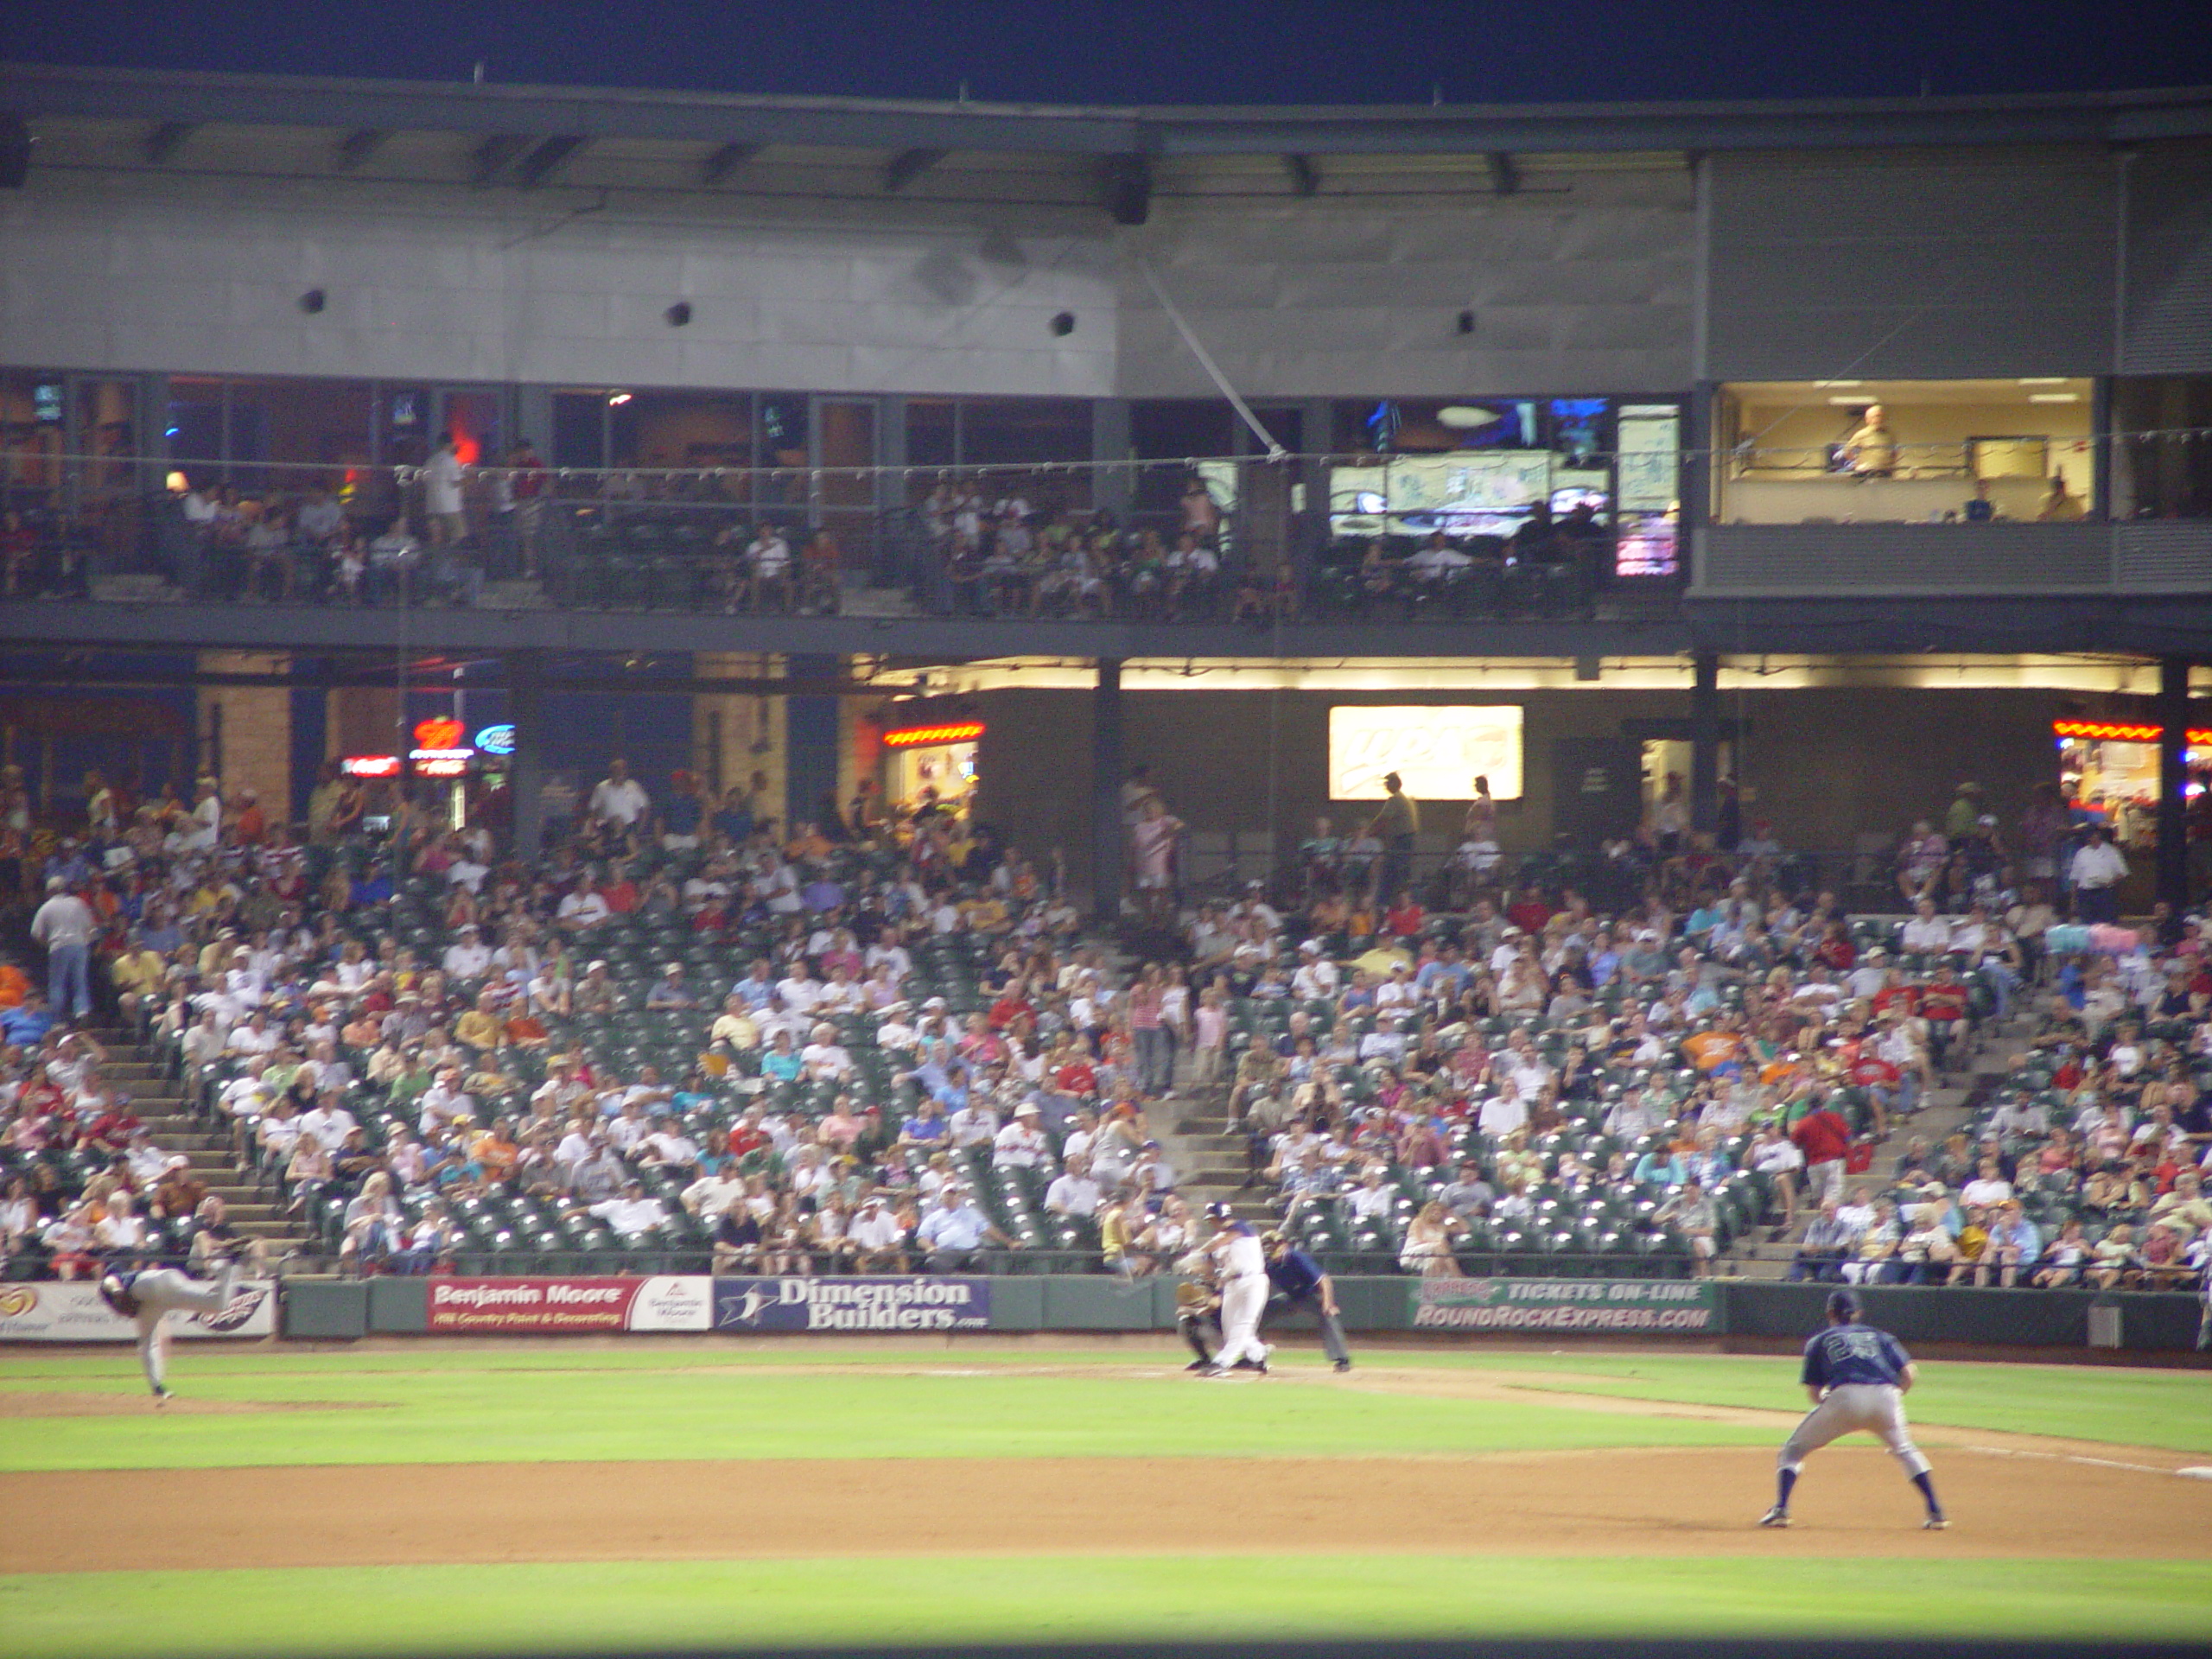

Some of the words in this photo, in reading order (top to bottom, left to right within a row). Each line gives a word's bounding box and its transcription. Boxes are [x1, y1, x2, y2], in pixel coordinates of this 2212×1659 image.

[434, 1285, 543, 1308] Benjamin
[545, 1285, 625, 1304] Moore
[777, 1277, 973, 1305] Dimension
[1507, 1283, 1606, 1301] TICKETS
[1607, 1283, 1703, 1301] ON-LINE
